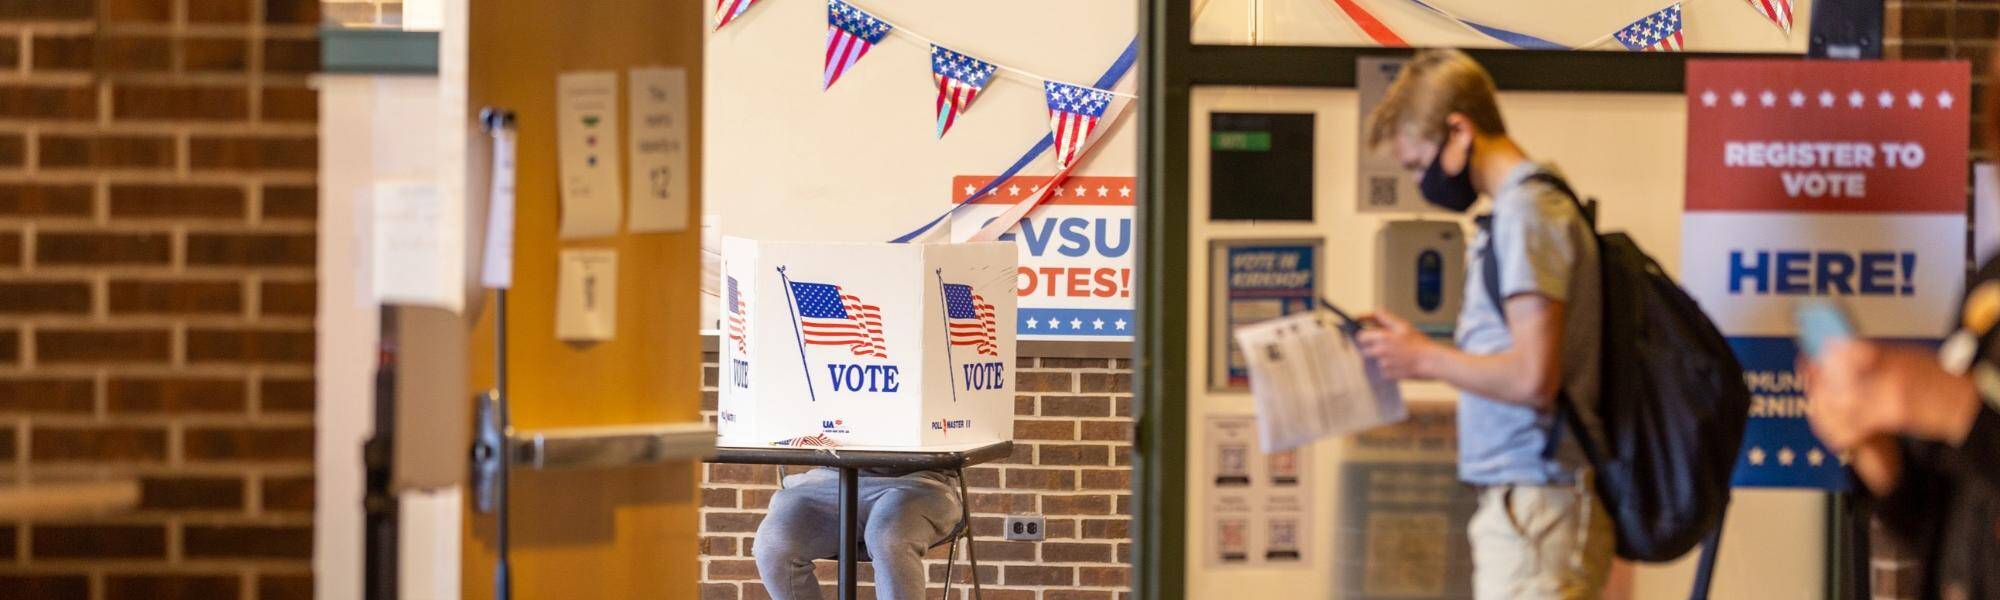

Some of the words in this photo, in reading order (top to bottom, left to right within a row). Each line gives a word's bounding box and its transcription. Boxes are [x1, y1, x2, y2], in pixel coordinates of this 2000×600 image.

[1724, 141, 1875, 167] REGISTER
[1881, 142, 1926, 168] TO
[1780, 171, 1867, 197] VOTE
[1017, 266, 1131, 298] OTES!
[1728, 251, 1917, 294] HERE!
[827, 363, 900, 393] VOTE
[963, 361, 1005, 392] VOTE
[1747, 394, 1816, 418] RNIN
[931, 421, 943, 430] POLL
[947, 420, 964, 429] MASTER
